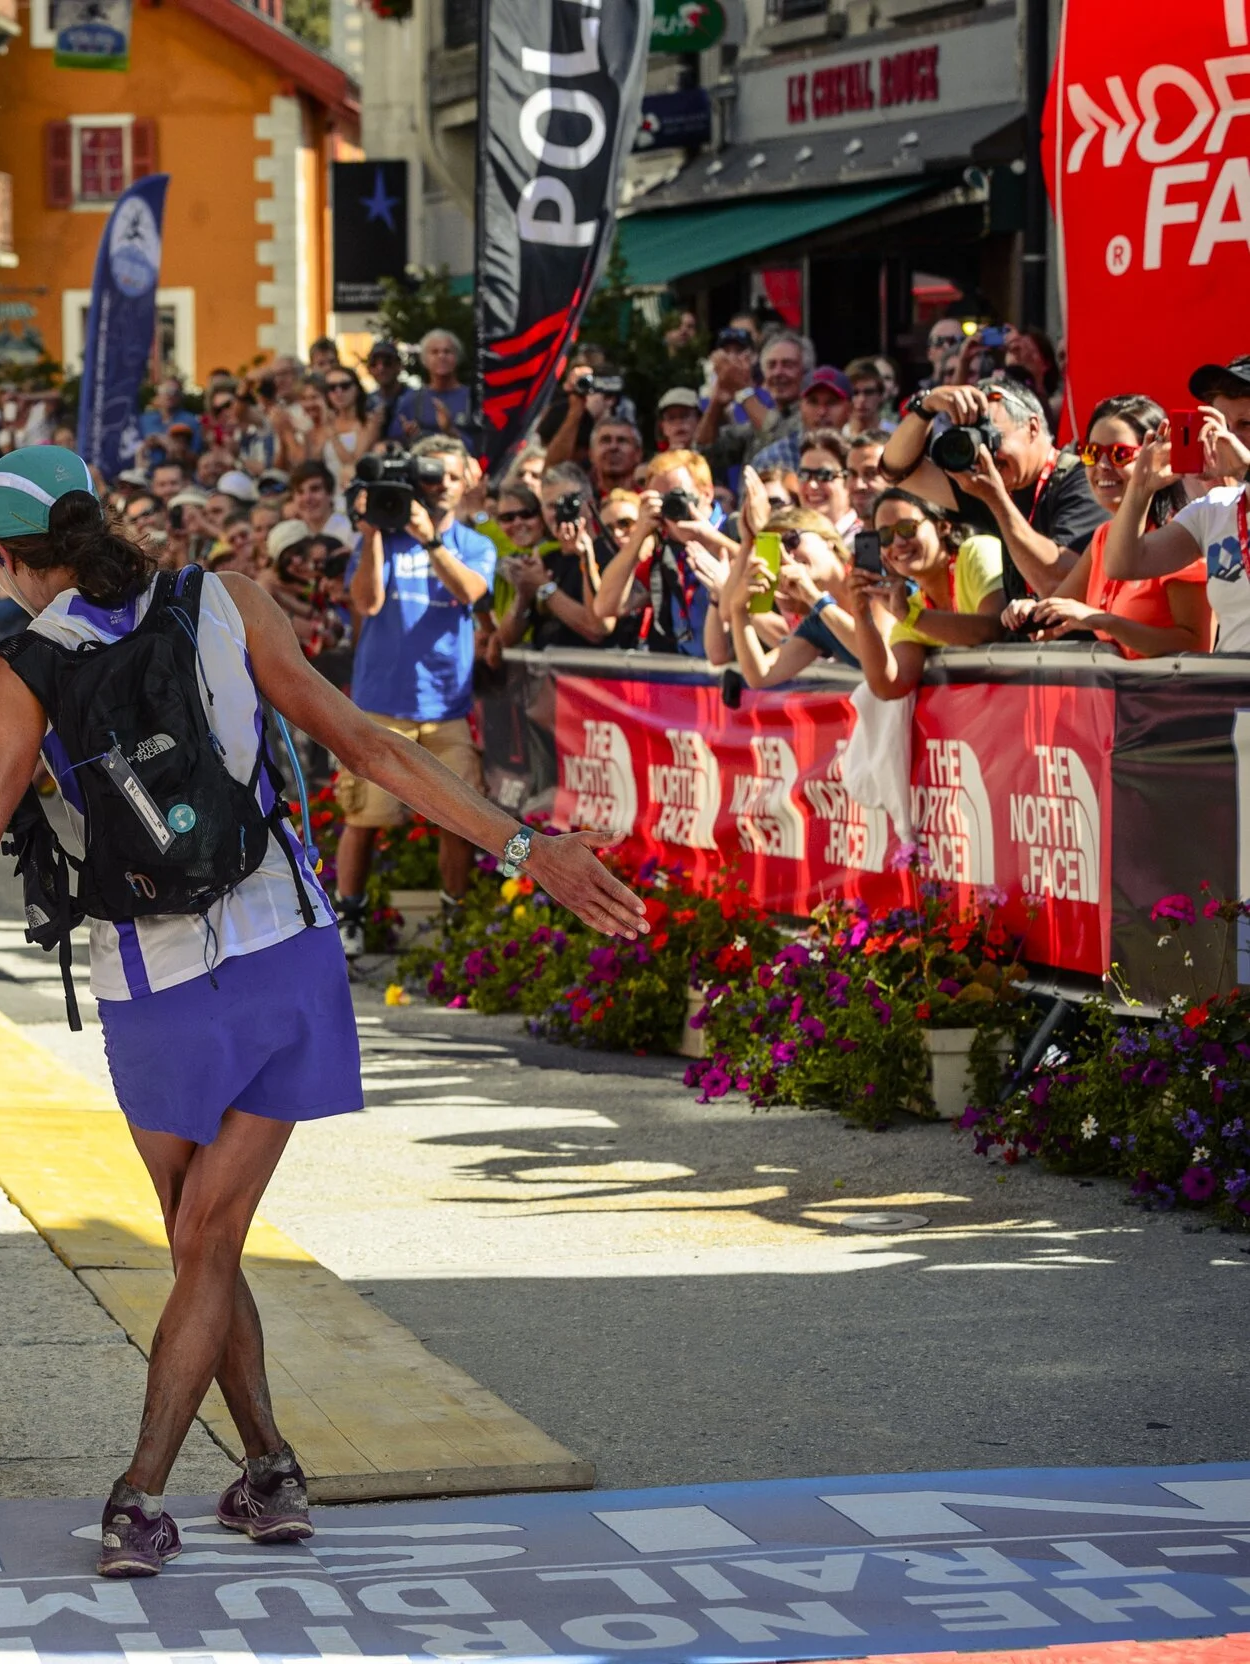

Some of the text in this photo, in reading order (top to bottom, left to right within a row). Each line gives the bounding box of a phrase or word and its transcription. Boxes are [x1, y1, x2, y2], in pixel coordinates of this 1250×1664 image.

[787, 73, 807, 124] LE
[879, 44, 939, 107] ROUGE
[126, 742, 159, 763] NORTH
[137, 737, 153, 749] THE
[137, 747, 161, 762] FACE
[583, 720, 613, 757] THE
[665, 729, 699, 767] THE
[751, 736, 783, 778] THE
[563, 755, 615, 799] NORTH
[926, 739, 960, 786] THE
[1035, 745, 1072, 797] THE
[649, 765, 699, 805] NORTH
[729, 774, 785, 817] NORTH
[655, 805, 696, 846] FACE
[738, 816, 783, 855] FACE
[1010, 794, 1080, 848] NORTH
[829, 821, 866, 869] FACE
[1029, 846, 1080, 900] FACE
[214, 1577, 497, 1619] DU
